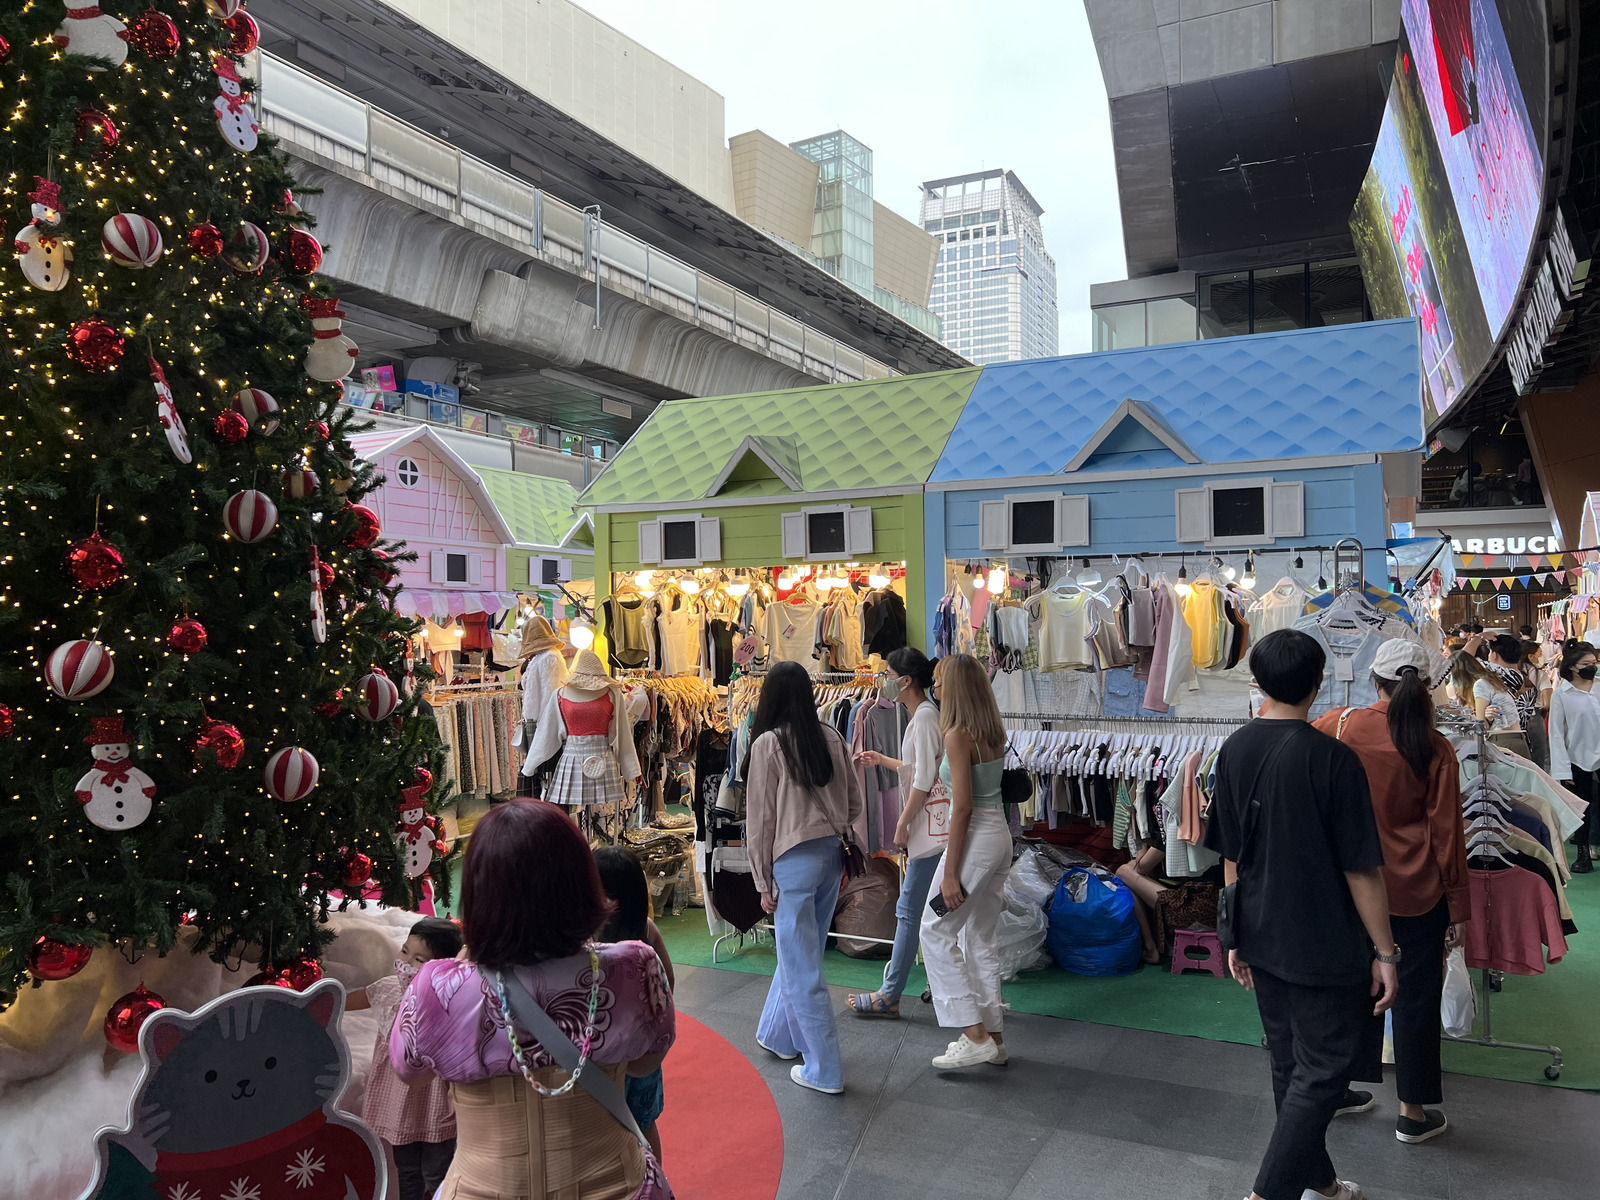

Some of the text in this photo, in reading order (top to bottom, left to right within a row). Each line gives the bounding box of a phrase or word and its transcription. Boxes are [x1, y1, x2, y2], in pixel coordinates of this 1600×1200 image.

[1506, 204, 1578, 397] SIAM SQUARE ONE
[740, 642, 755, 655] 200
